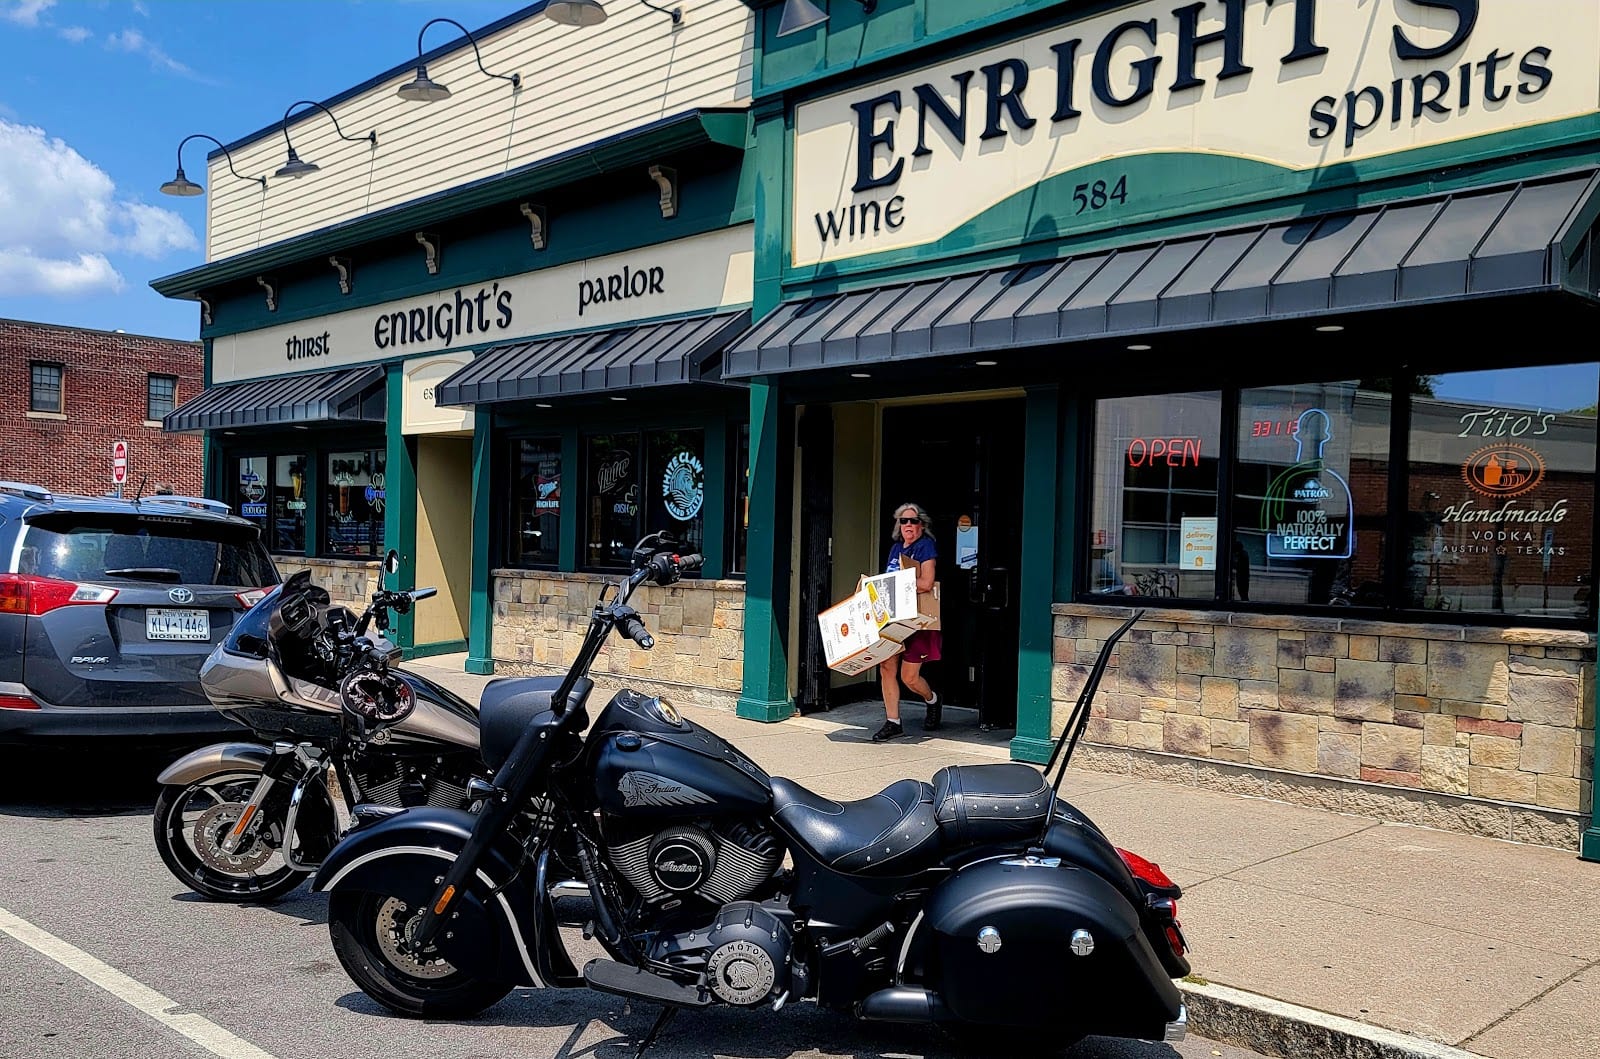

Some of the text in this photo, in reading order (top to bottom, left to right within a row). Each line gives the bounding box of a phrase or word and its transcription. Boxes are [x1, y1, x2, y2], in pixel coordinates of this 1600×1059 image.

[850, 0, 1478, 193] ENRIGHTS
[1072, 174, 1129, 215] 584
[1458, 408, 1556, 438] Tito's
[1128, 438, 1201, 467] OPEN
[662, 455, 680, 497] WHITE
[678, 451, 704, 473] CLAW
[1296, 510, 1327, 523] 100%
[1441, 499, 1567, 522] Handmade
[1276, 523, 1344, 537] NATURALLY
[1472, 531, 1532, 541] VODKA
[1283, 535, 1336, 550] PERFECT
[1442, 545, 1565, 555] AUSTIN TEXAS
[645, 783, 682, 793] Indian
[659, 860, 698, 872] Indian
[727, 943, 773, 994] MOTORCYCLE
